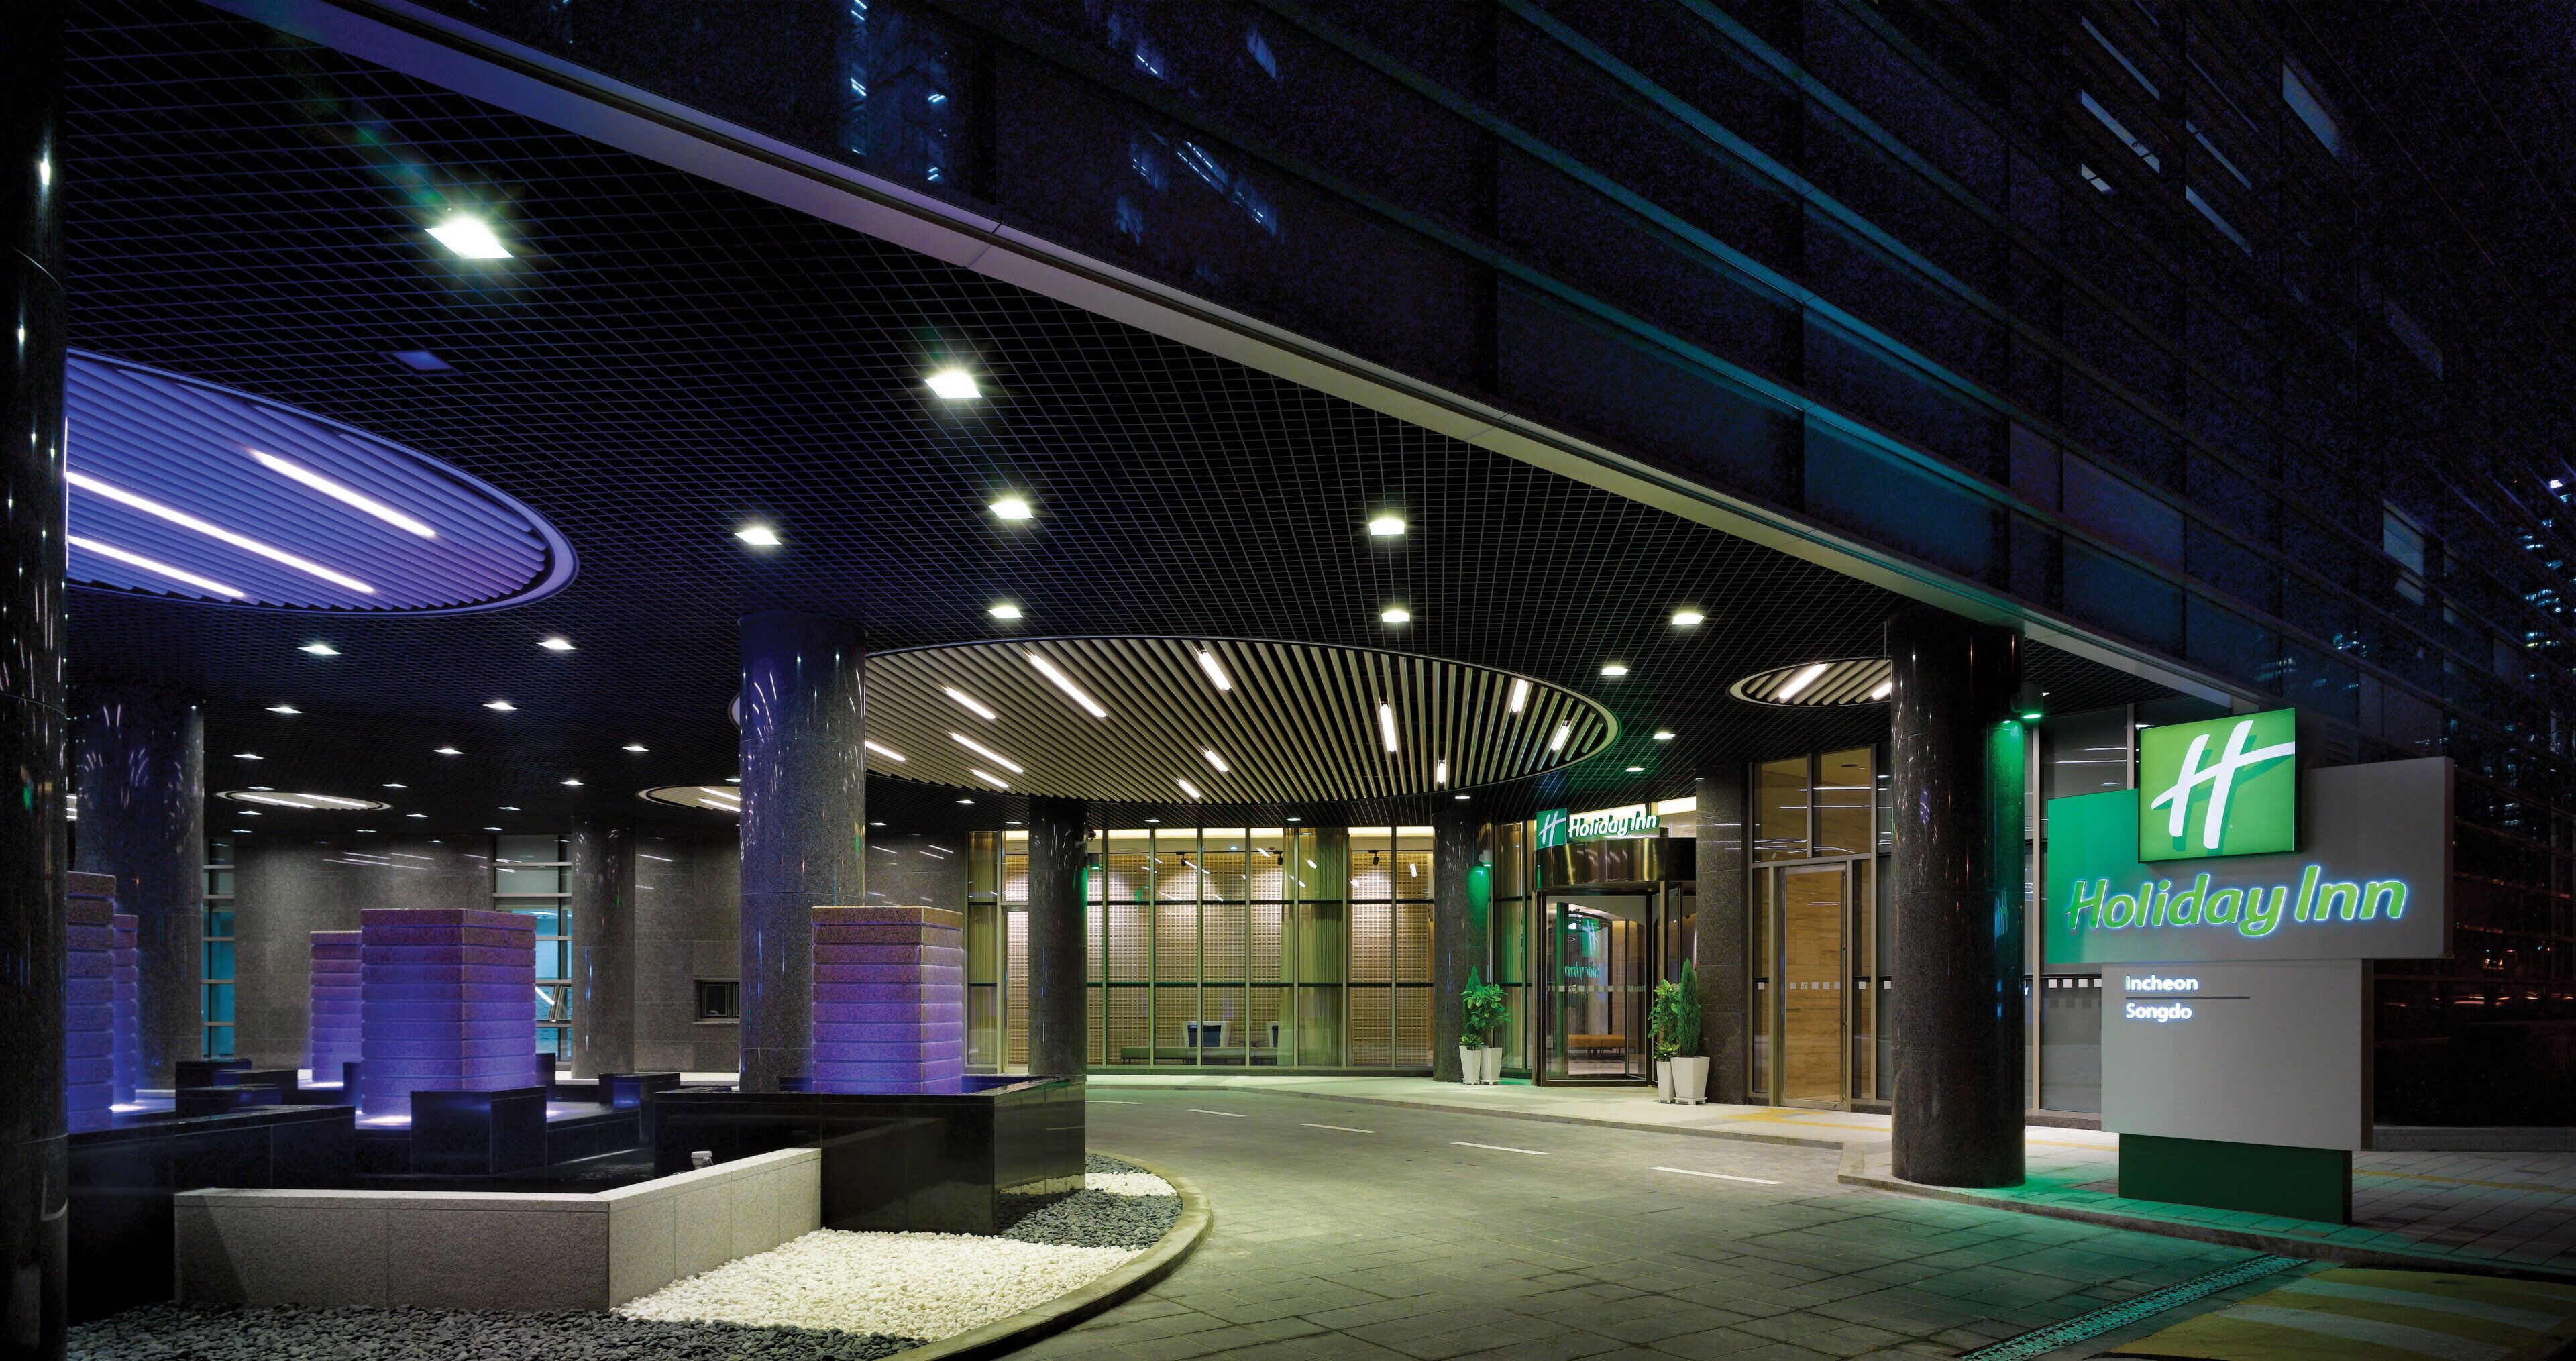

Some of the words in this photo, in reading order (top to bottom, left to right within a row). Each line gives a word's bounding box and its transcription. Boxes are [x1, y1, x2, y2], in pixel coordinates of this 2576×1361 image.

[2151, 720, 2295, 849] H
[1538, 811, 1566, 847] H
[1568, 814, 1629, 837] Holiday
[1630, 811, 1659, 831] Inn
[2064, 873, 2286, 937] Holiday
[2294, 865, 2408, 922] Inn
[2125, 974, 2199, 991] Incheon
[2125, 1002, 2193, 1023] Songdo
